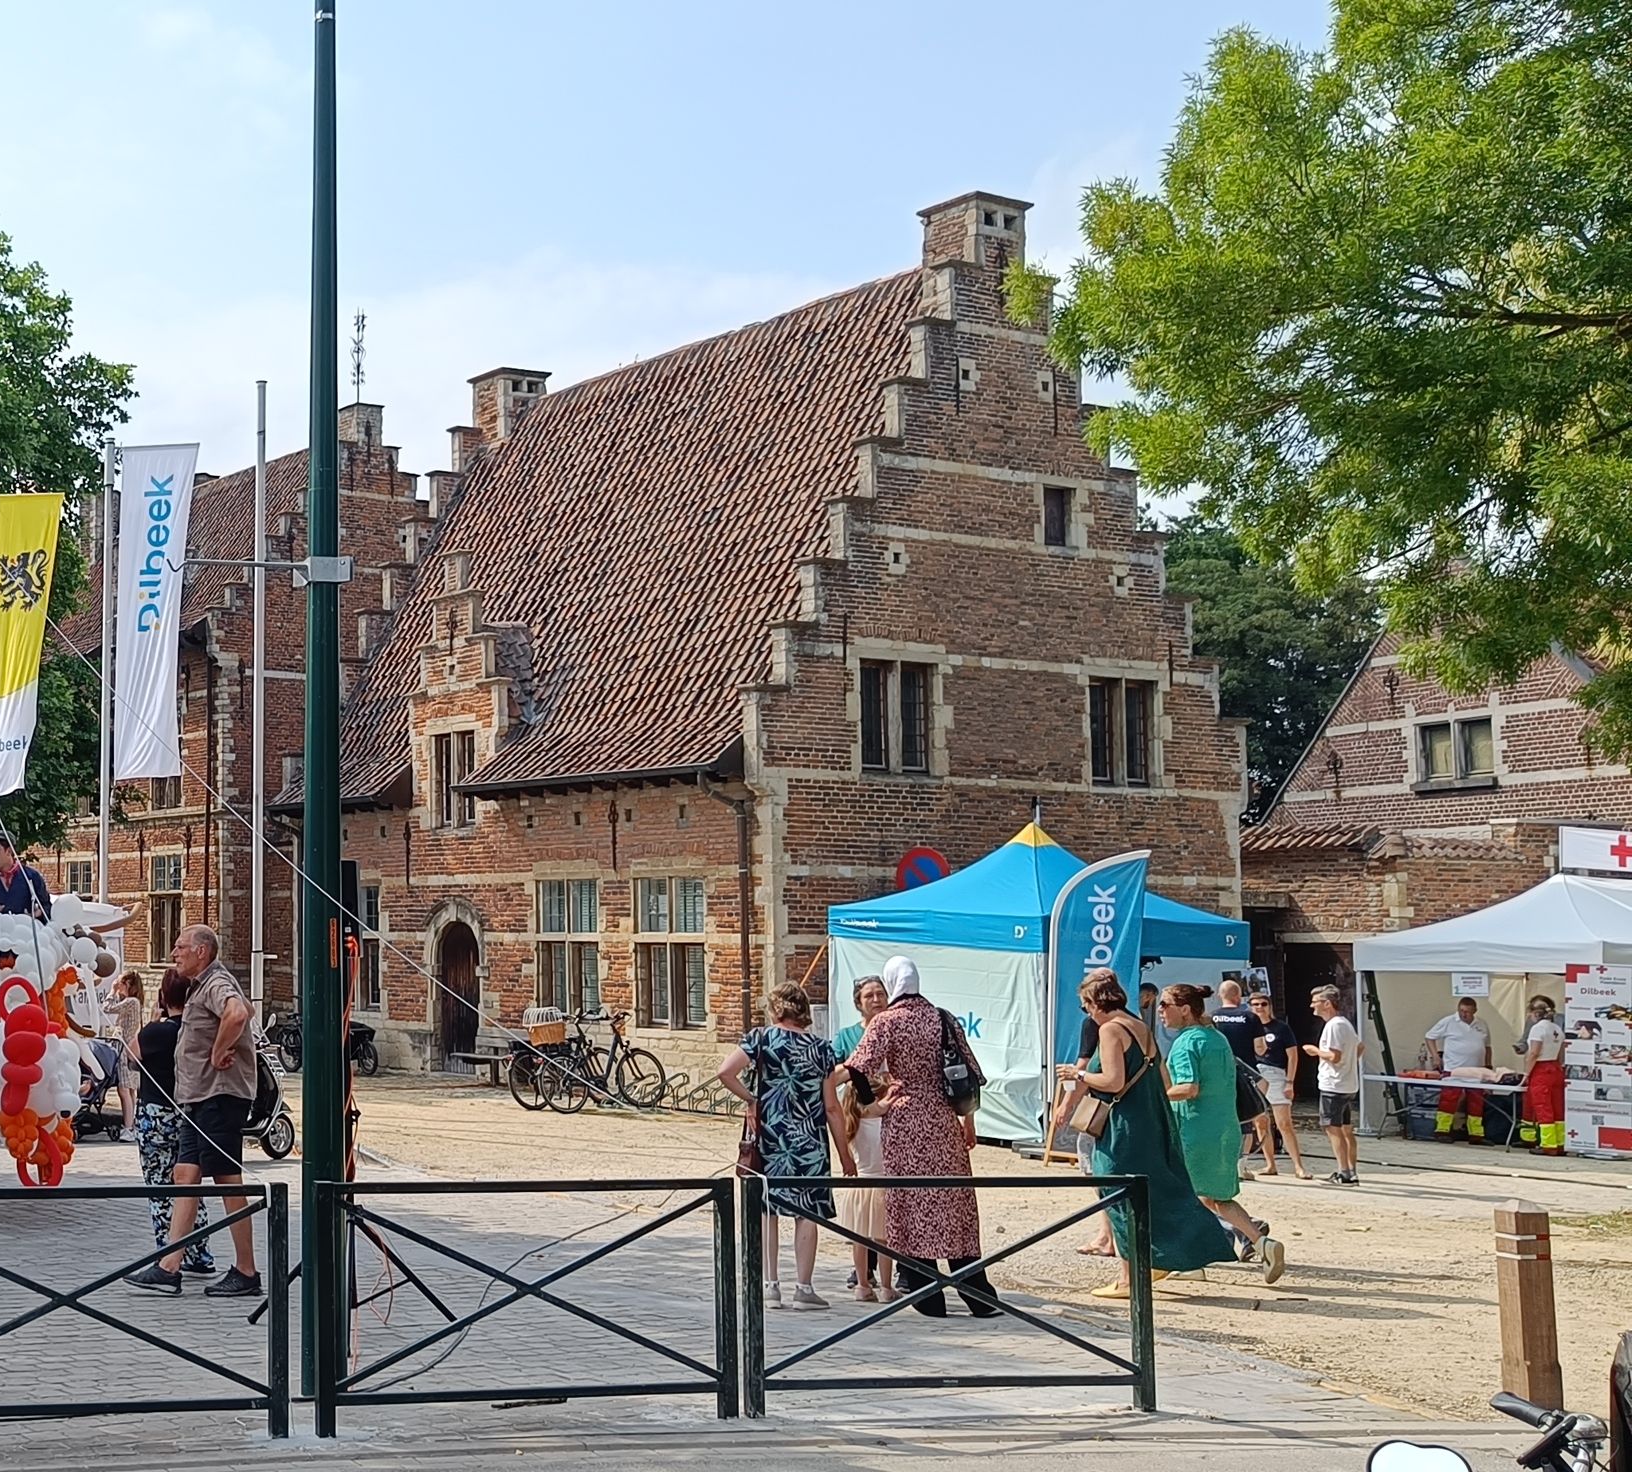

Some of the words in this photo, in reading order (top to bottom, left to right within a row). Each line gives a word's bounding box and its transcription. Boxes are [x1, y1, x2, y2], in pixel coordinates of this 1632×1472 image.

[137, 474, 174, 632] Dilbeek
[1084, 884, 1117, 974] lbeek
[1580, 987, 1617, 997] Dilbeek
